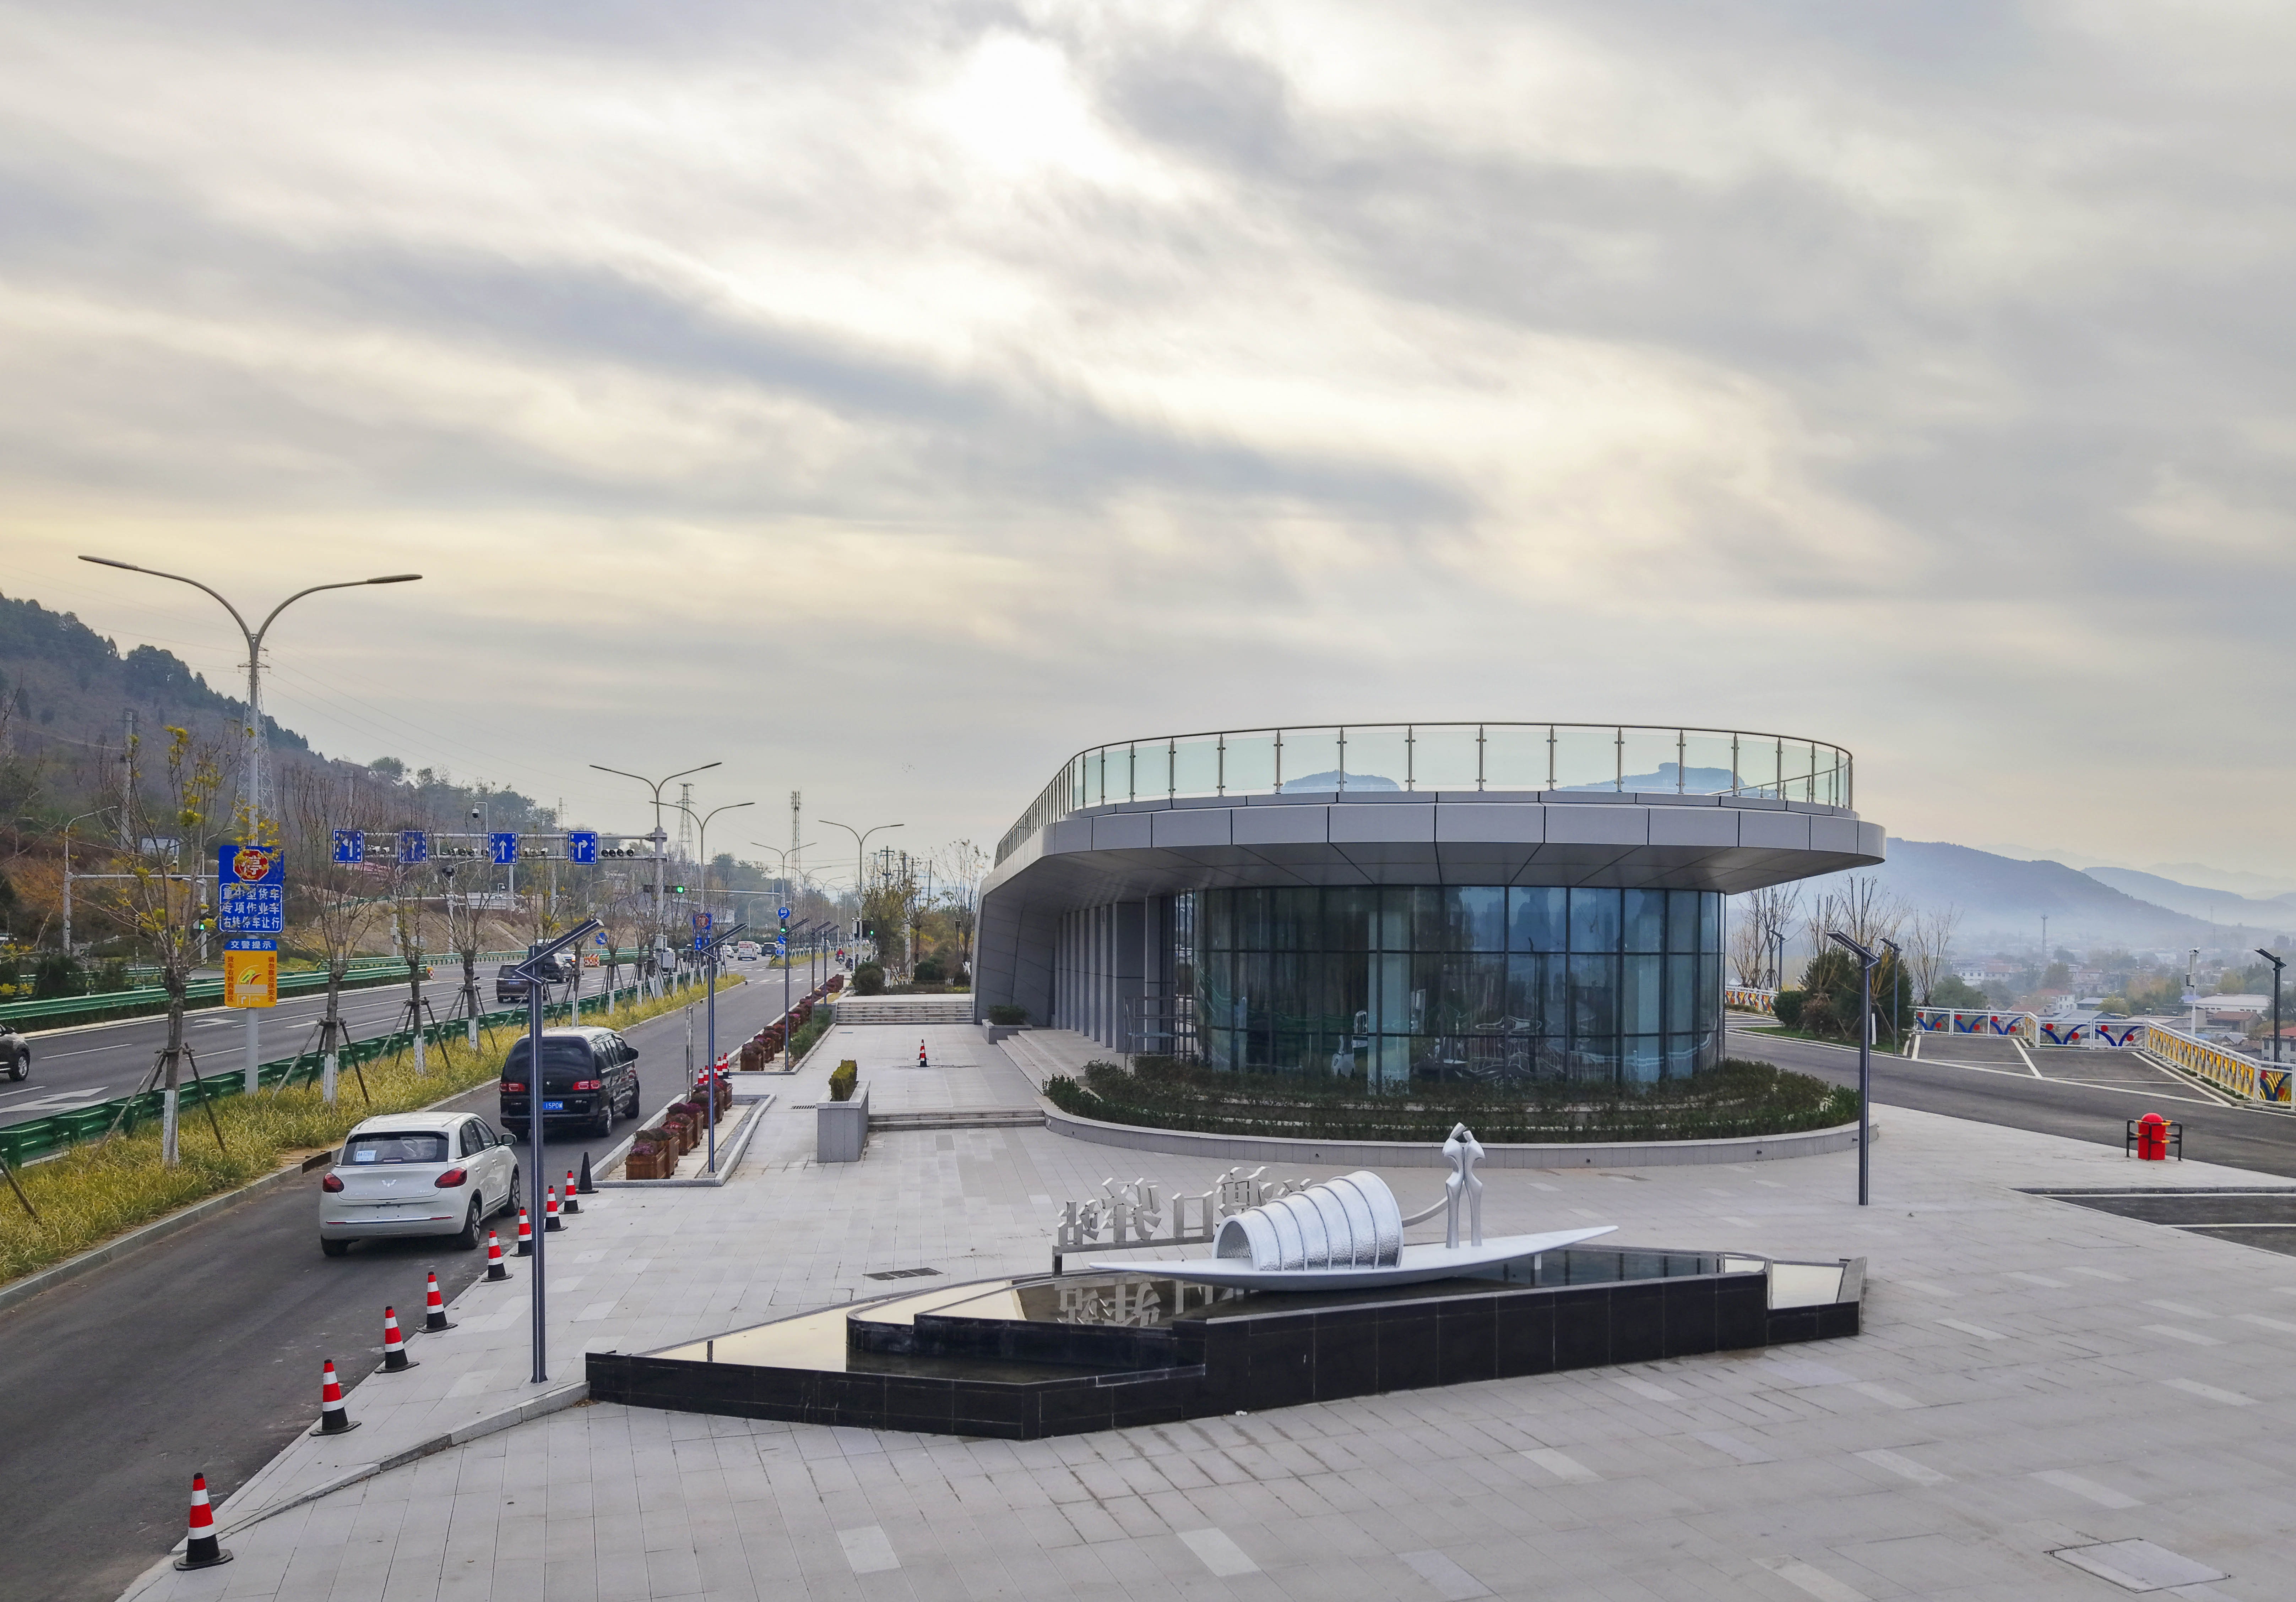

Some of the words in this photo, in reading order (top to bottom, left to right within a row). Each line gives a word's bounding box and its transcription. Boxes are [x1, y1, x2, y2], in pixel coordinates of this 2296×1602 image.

[241, 855, 262, 875] 停
[223, 886, 279, 900] 重中型货车
[222, 902, 280, 915] 专项作业车
[223, 916, 280, 929] 右转停车让行
[231, 940, 271, 949] 交警提示
